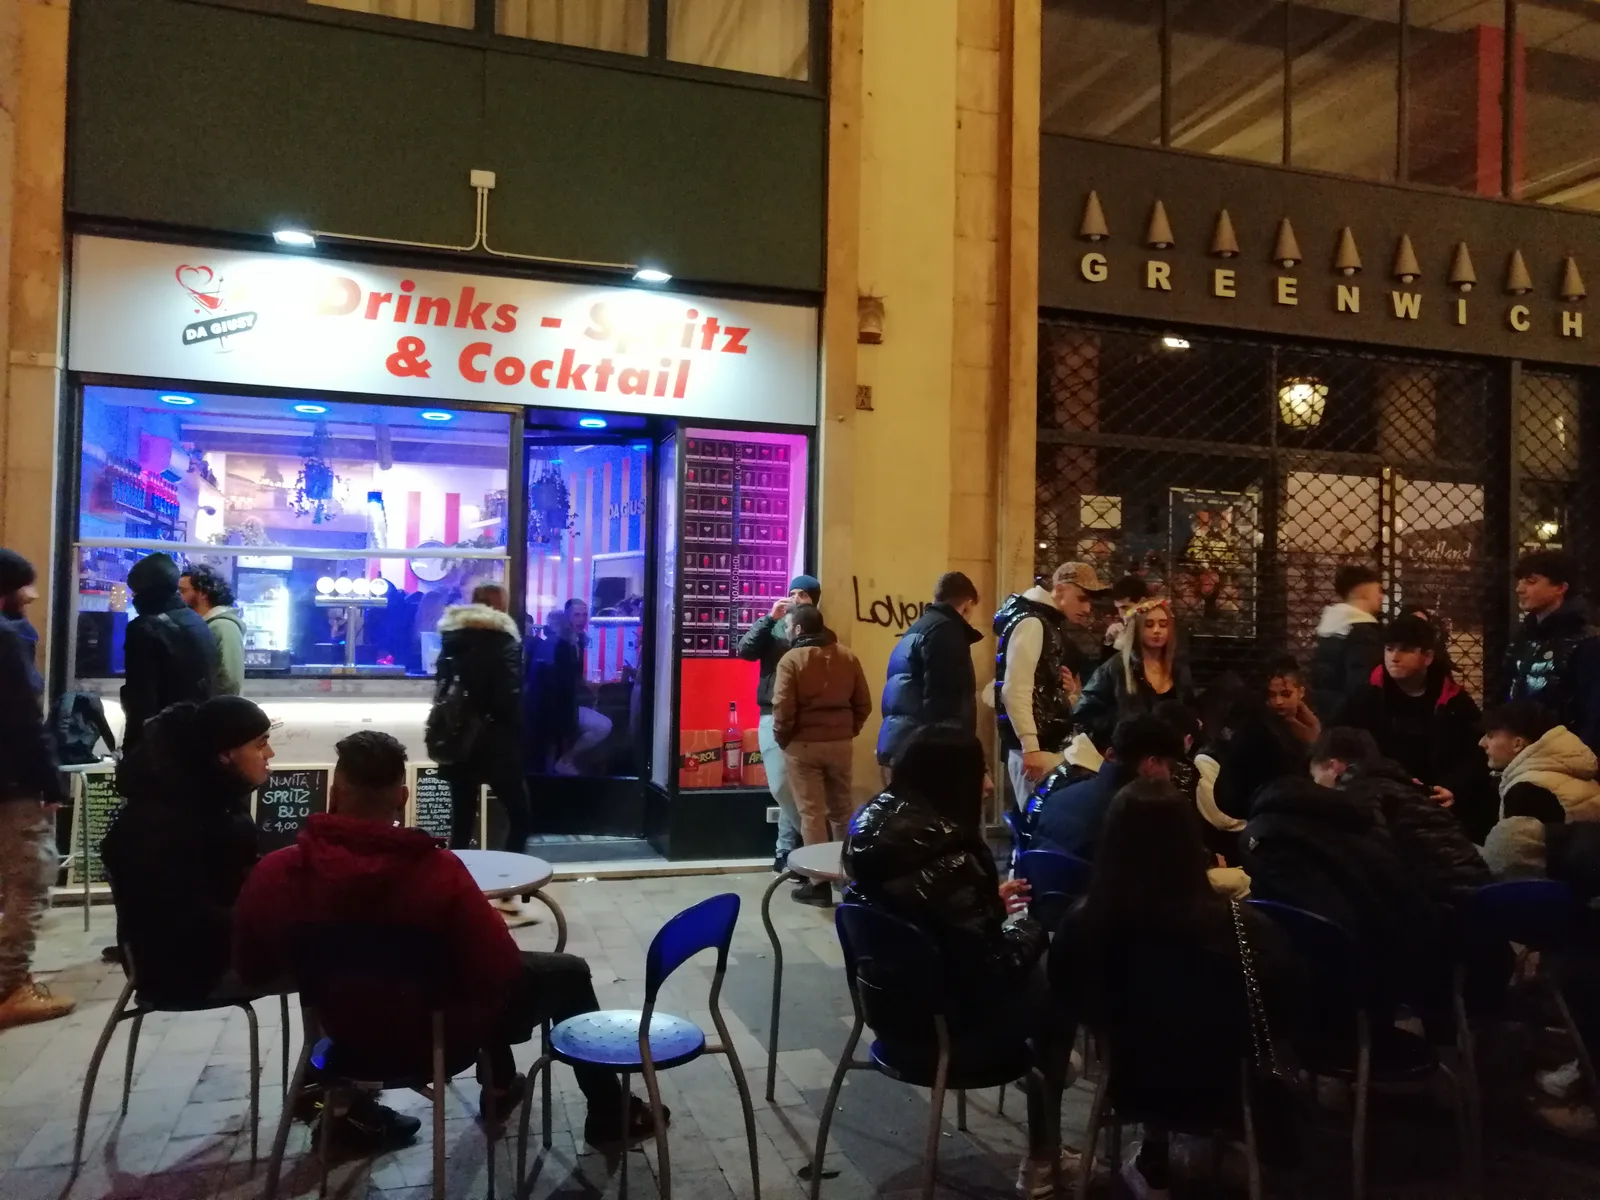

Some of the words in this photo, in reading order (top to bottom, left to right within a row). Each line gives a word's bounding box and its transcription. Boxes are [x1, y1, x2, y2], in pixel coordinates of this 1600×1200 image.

[1081, 252, 1583, 337] GREENWICH
[185, 326, 208, 341] DA
[210, 313, 255, 335] GIUSY
[318, 276, 519, 333] Drinks
[584, 302, 751, 354] Sitz
[385, 336, 432, 379] &
[458, 341, 692, 399] Cocktail
[620, 497, 646, 517] GIUS
[262, 787, 310, 804] SPRITZ
[278, 806, 309, 818] BLU
[274, 821, 299, 833] 4,00
